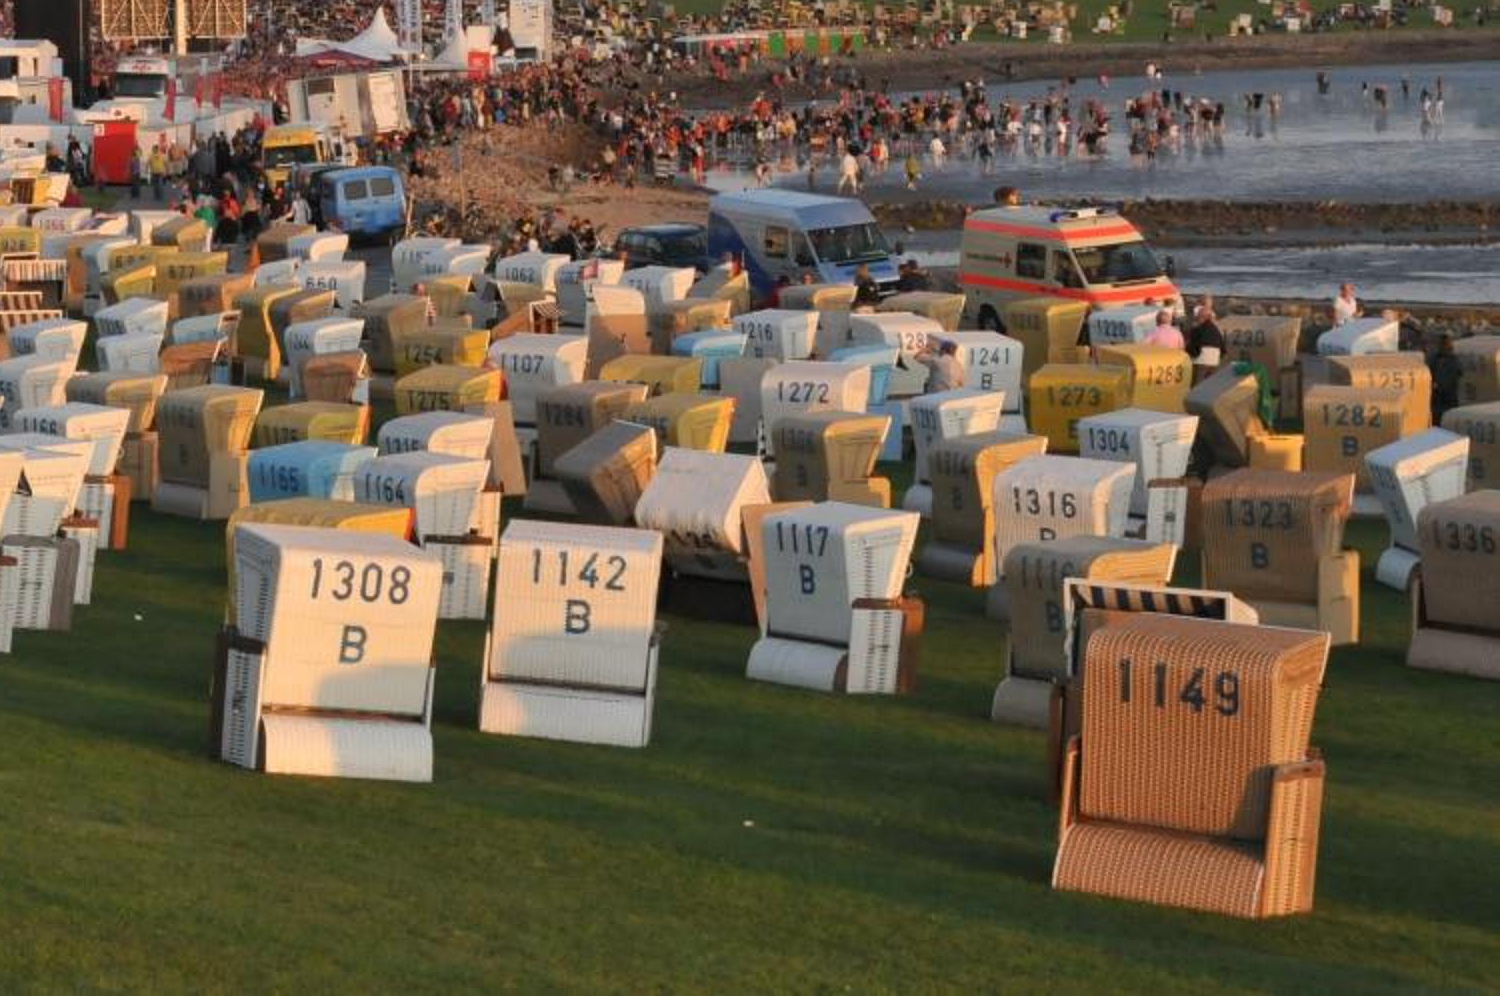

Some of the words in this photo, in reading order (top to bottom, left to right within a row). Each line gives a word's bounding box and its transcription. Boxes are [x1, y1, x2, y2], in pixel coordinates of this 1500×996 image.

[970, 347, 1009, 365] 1241
[777, 382, 829, 403] 1272
[981, 373, 992, 390] B
[1321, 405, 1382, 428] 1282
[1089, 428, 1129, 452] 1304
[1342, 436, 1358, 456] B
[1013, 487, 1077, 518] 1316
[776, 521, 829, 556] 1117
[1432, 520, 1496, 553] 1336
[531, 549, 627, 591] 1142
[1251, 542, 1268, 569] B
[311, 558, 412, 605] 1308
[800, 565, 815, 594] B
[564, 599, 591, 634] B
[339, 625, 367, 664] B
[1119, 658, 1240, 716] 1149
